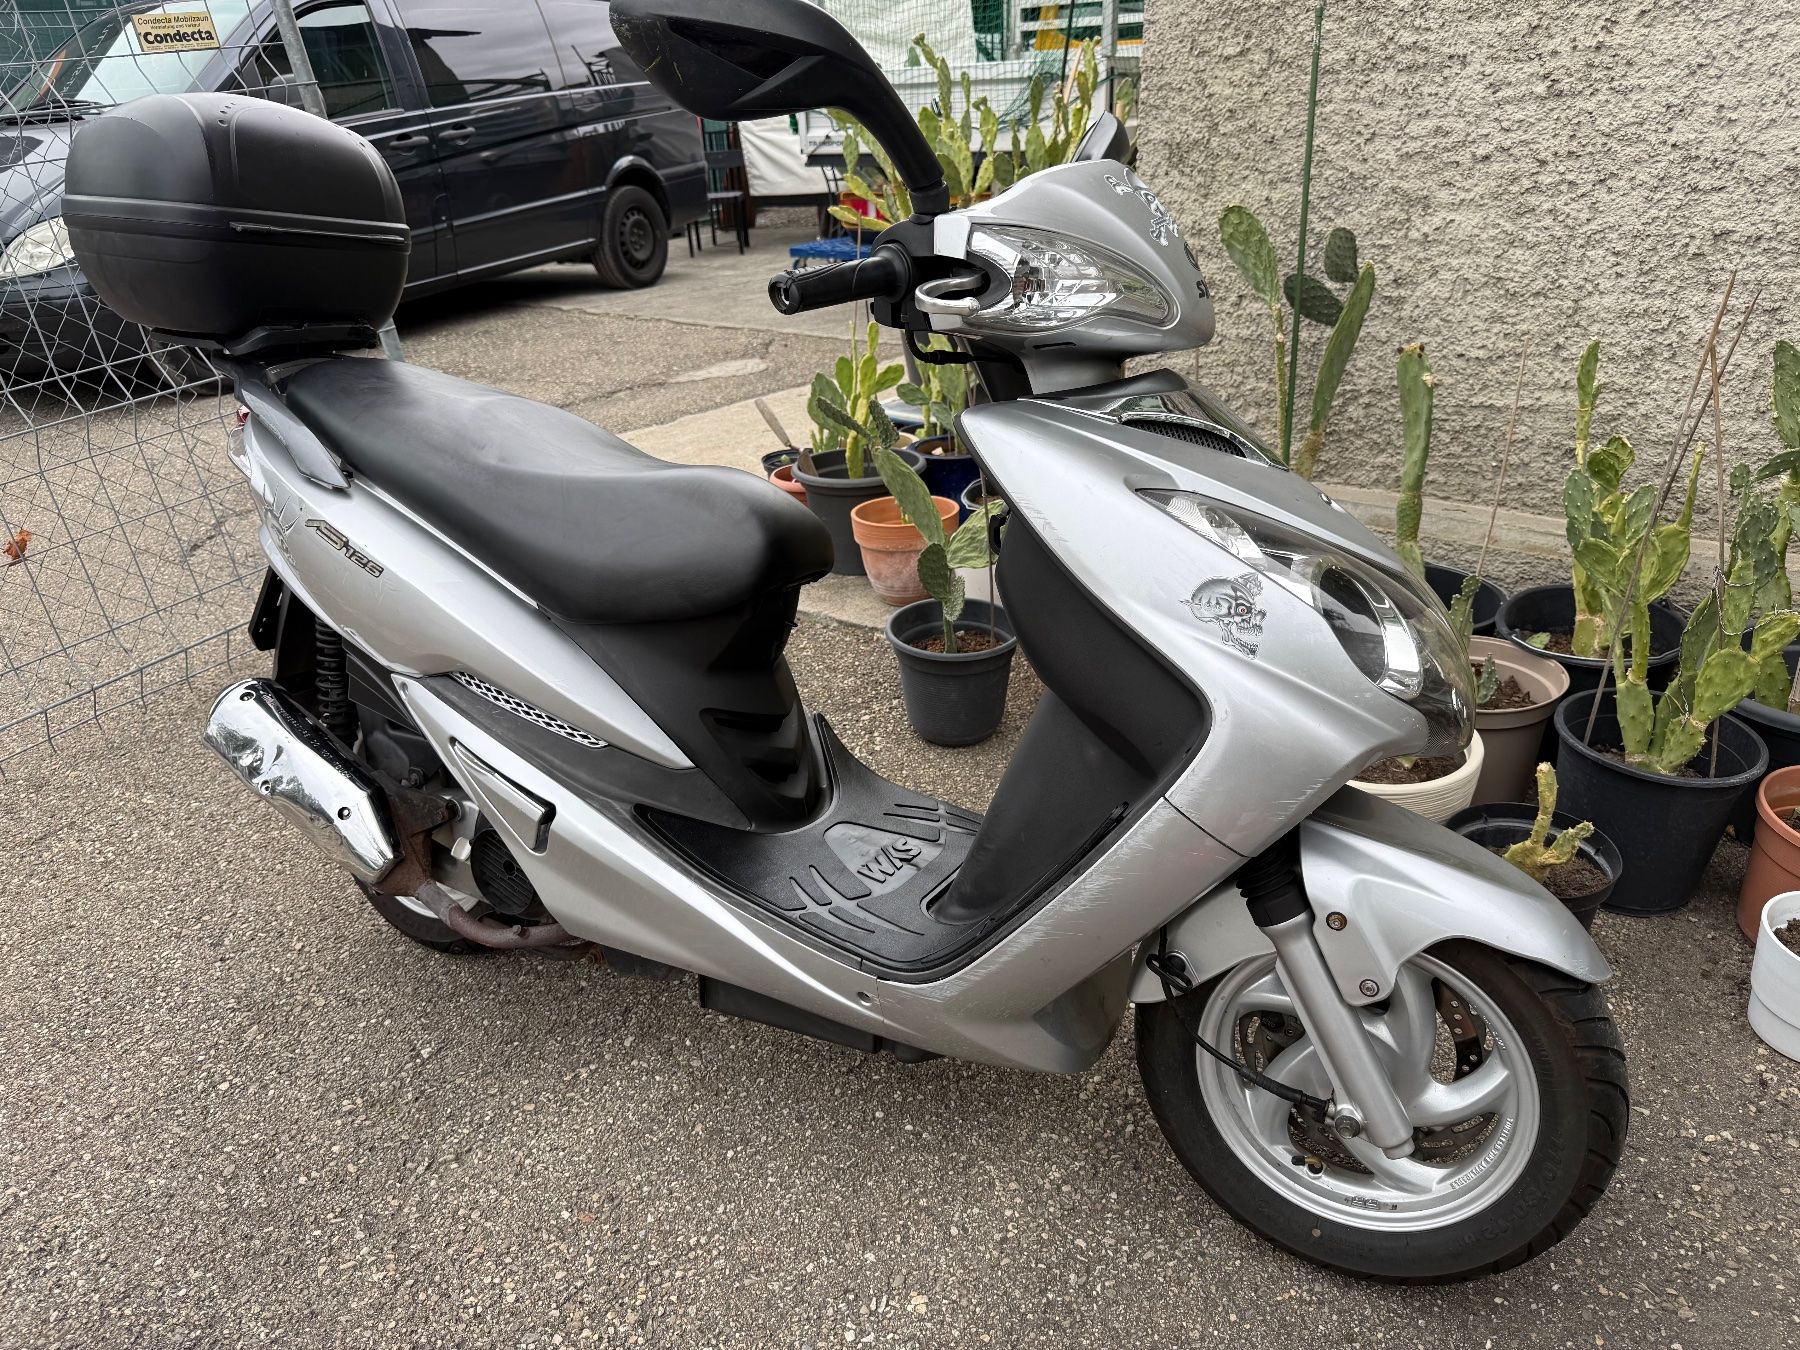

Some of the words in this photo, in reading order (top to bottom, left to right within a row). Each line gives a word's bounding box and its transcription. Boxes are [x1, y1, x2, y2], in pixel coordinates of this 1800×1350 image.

[137, 16, 172, 26] Condecta
[143, 28, 214, 44] Condecta
[333, 761, 352, 779] TOUCH
